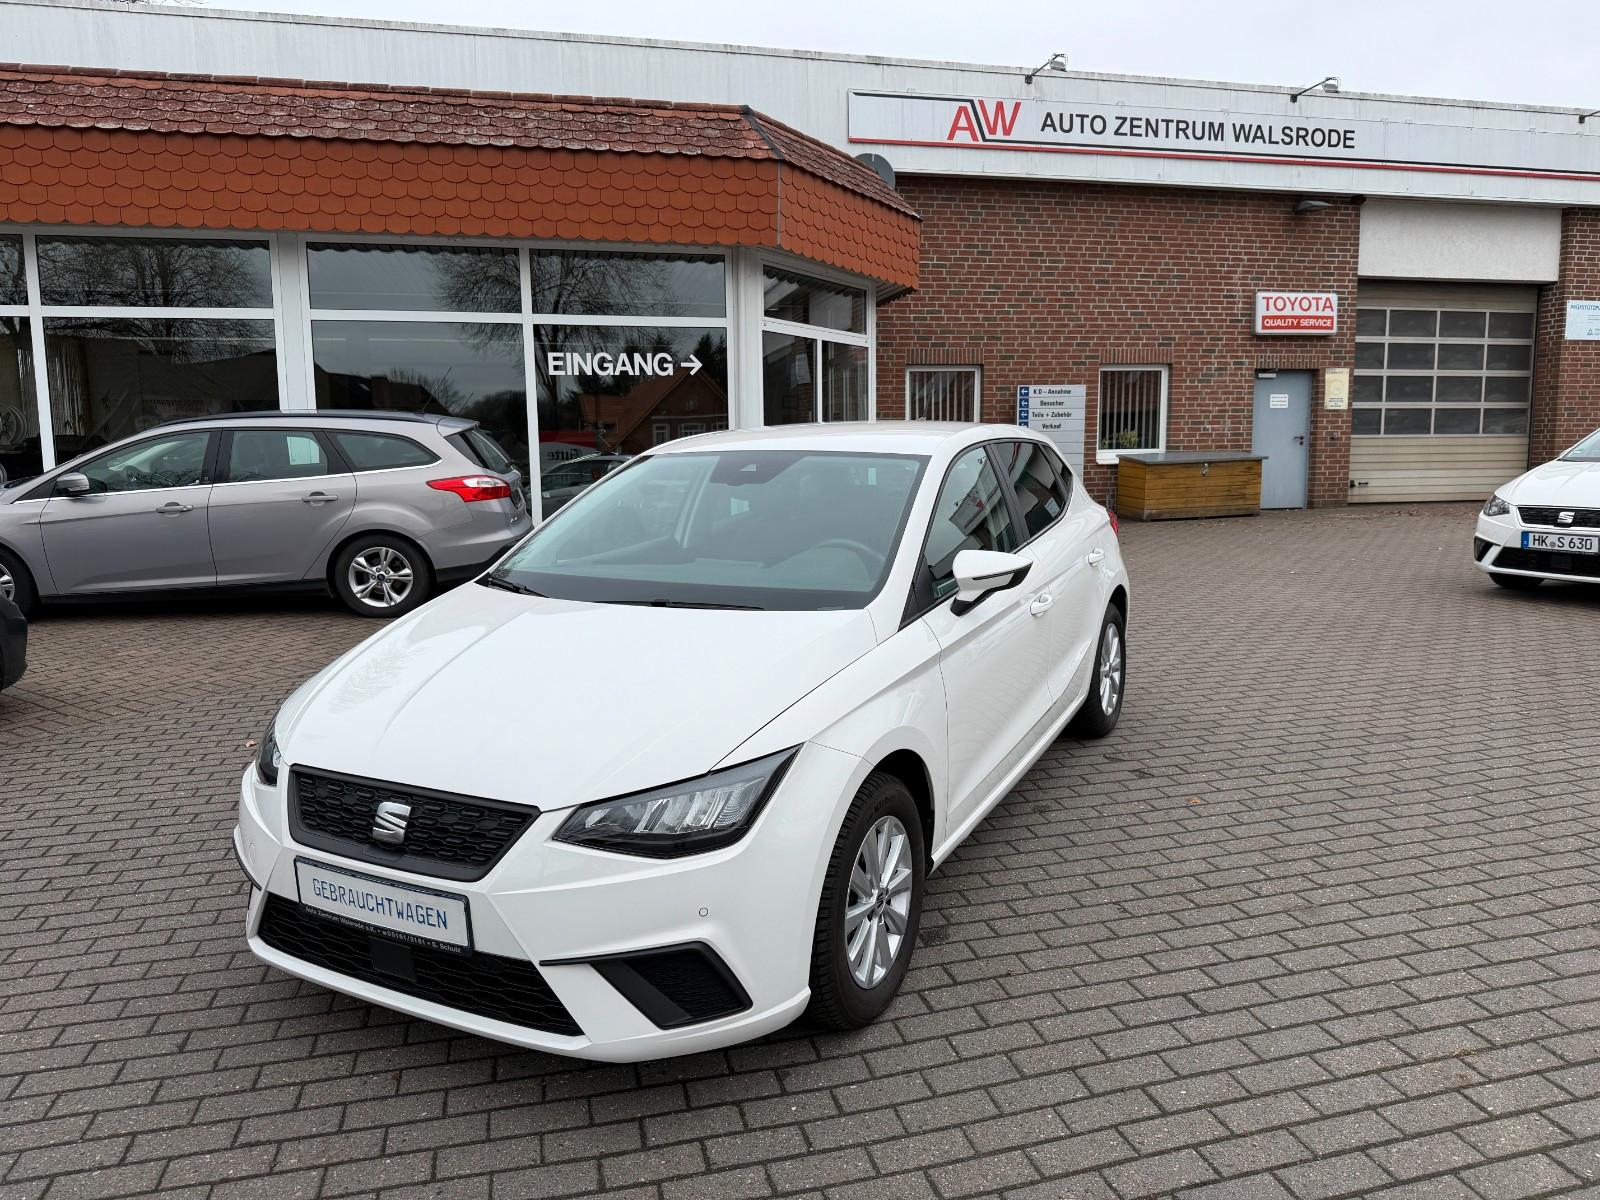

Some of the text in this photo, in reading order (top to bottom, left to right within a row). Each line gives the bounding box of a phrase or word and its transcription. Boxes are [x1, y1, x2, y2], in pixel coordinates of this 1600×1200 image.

[1040, 111, 1356, 149] AUTO ZENTRUM WALSRODE
[1262, 296, 1334, 312] TOYOTA
[1264, 318, 1332, 327] QUALITY SERVICE
[547, 352, 674, 377] EINGANG
[1532, 534, 1593, 551] HK S 630
[312, 878, 448, 930] GEBRAUCHTWAGEN
